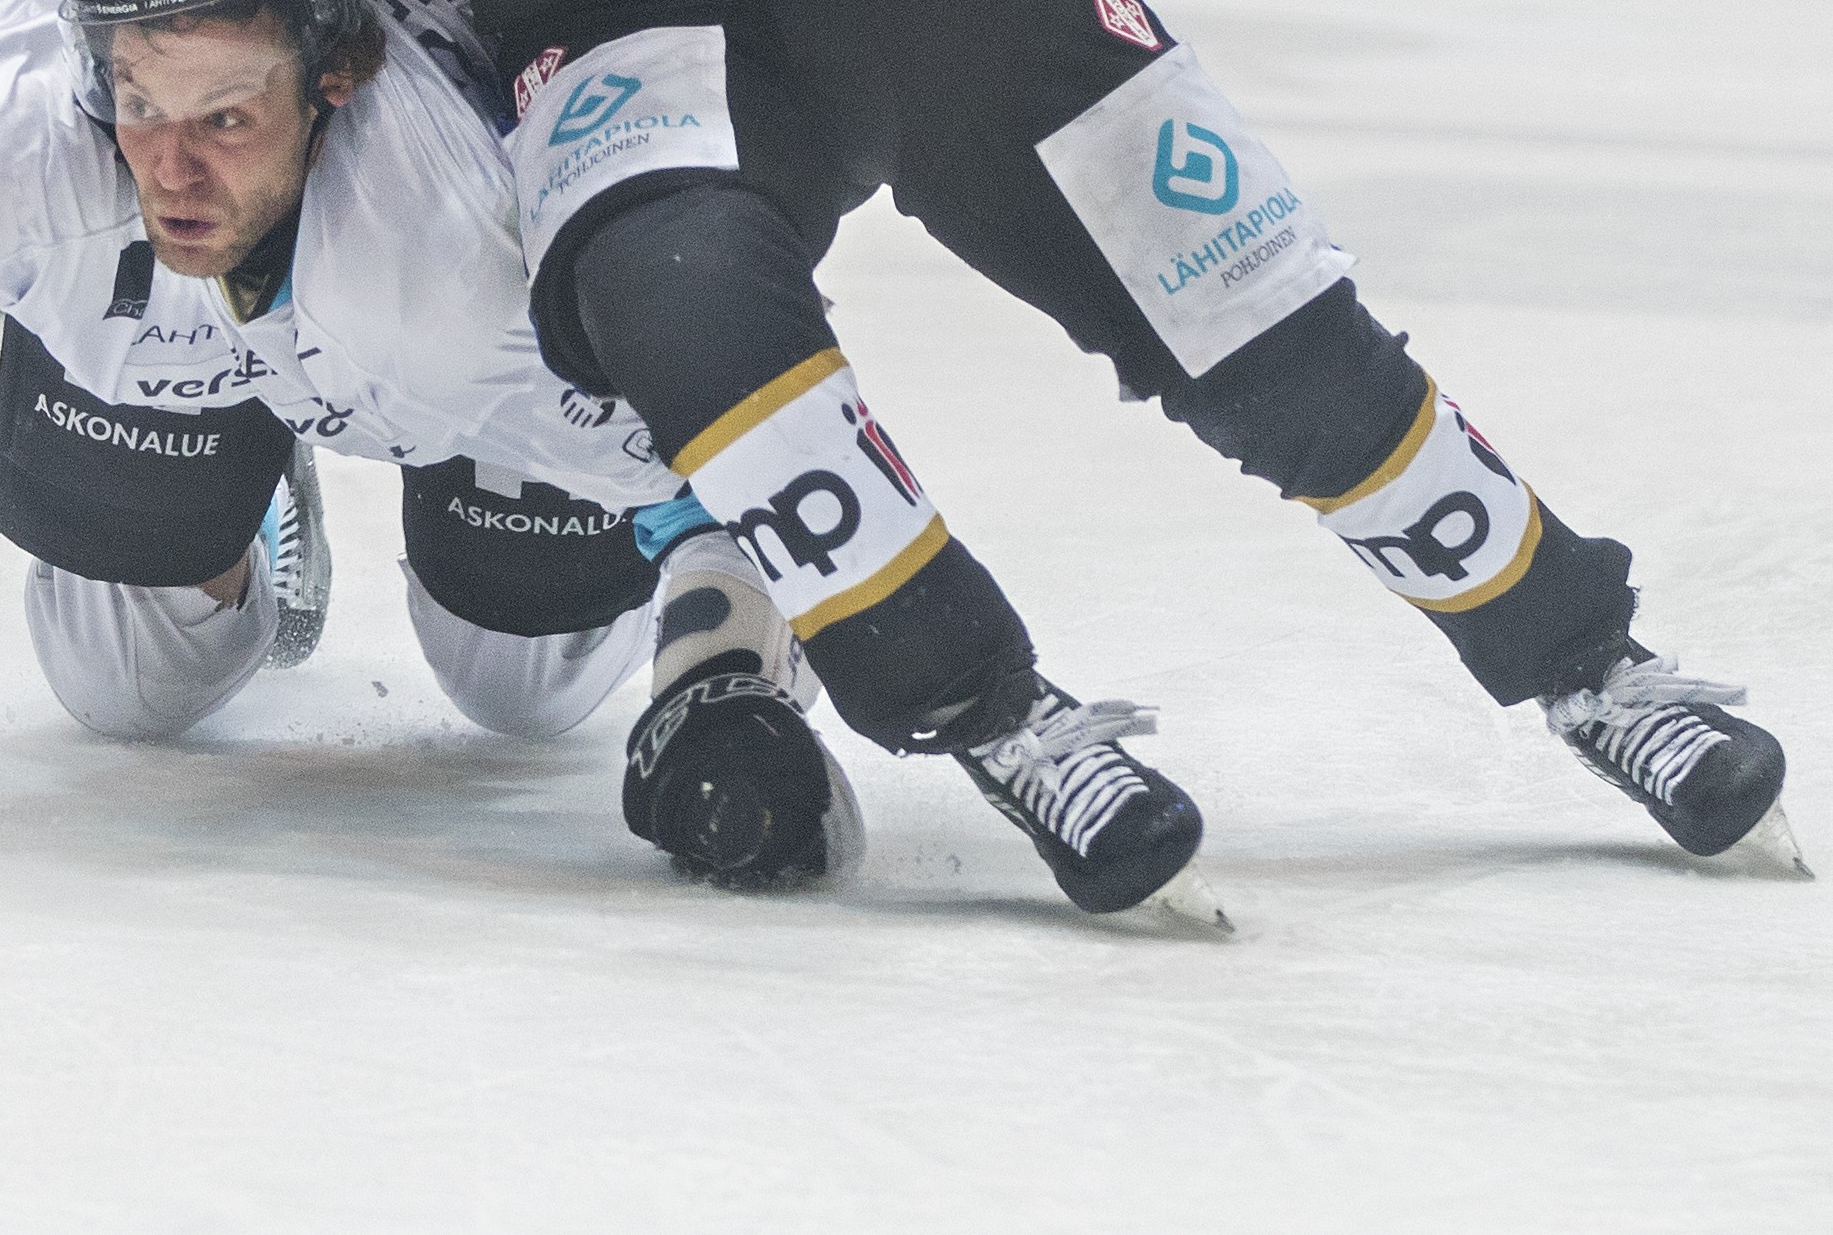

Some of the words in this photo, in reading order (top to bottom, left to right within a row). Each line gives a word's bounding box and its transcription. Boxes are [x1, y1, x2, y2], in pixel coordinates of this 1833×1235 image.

[1156, 186, 1304, 296] LÄHITAPIOLA
[1219, 225, 1297, 289] POHJOINEN
[33, 392, 222, 458] ASKONALUE
[446, 495, 629, 537] ASKONALU
